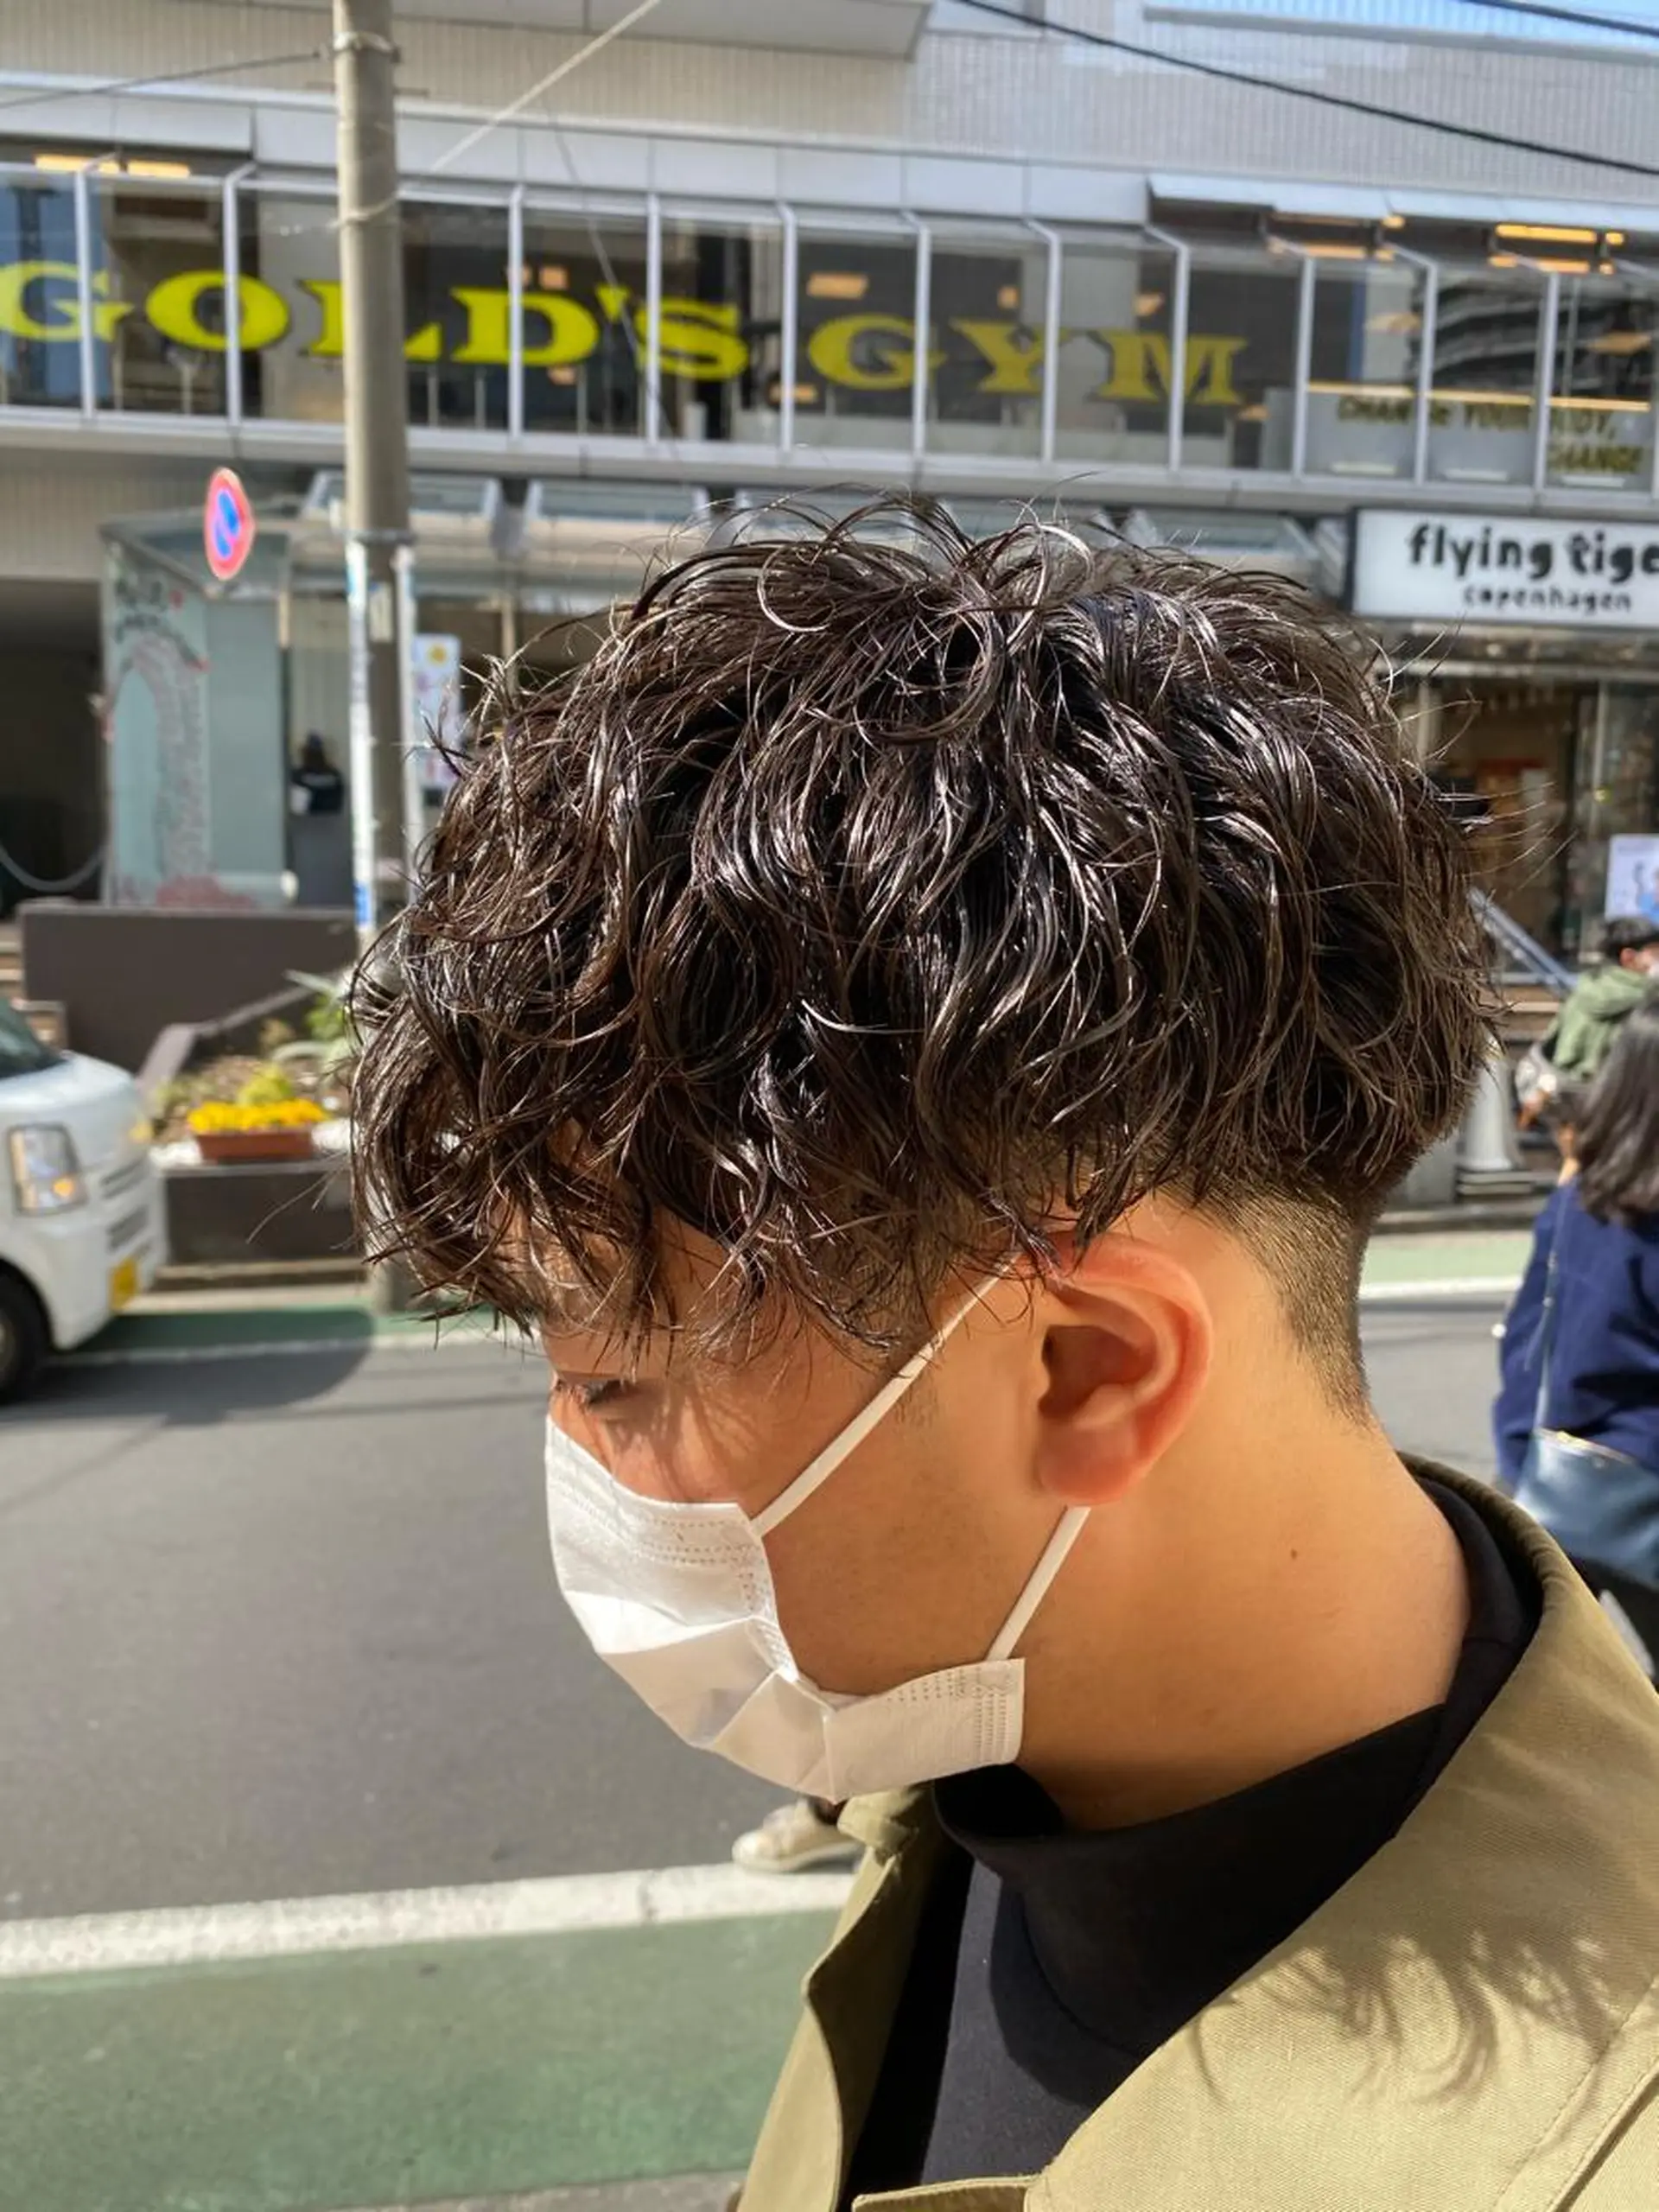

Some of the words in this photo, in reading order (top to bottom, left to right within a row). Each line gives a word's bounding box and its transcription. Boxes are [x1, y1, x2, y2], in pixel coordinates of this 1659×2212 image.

[0, 262, 747, 381] GOLD'S
[808, 313, 1248, 405] GYM
[1408, 524, 1554, 581] flying
[1465, 585, 1631, 614] copenhagen
